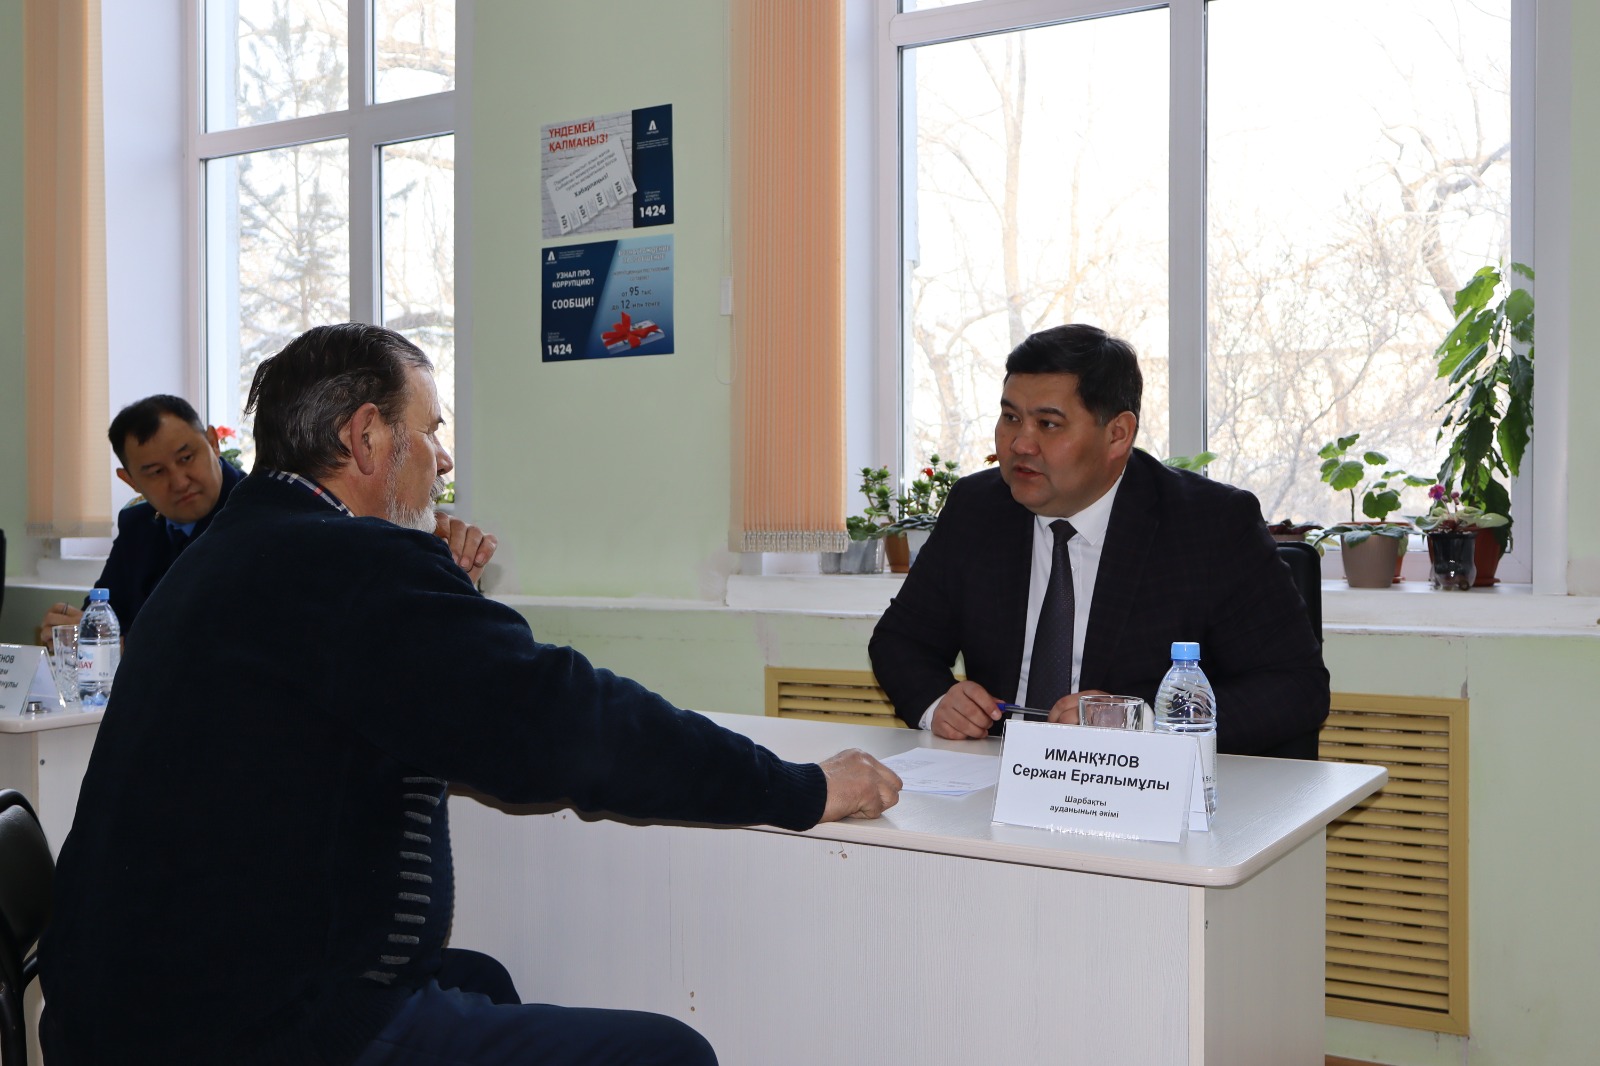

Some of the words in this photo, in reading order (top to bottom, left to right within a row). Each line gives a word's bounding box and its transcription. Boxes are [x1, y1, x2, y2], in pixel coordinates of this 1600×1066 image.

[549, 120, 595, 138] ҮНДЕМЕЙ
[549, 133, 609, 152] ҚАЛМАҢЫЗ!
[640, 204, 666, 218] 1424
[556, 270, 577, 279] УЗНАЛ
[577, 269, 591, 277] ПРО
[552, 278, 594, 288] КОРРУПЦИЮ?
[629, 286, 639, 296] 95
[552, 297, 594, 309] СООБЩИ!
[621, 299, 630, 309] 12
[548, 343, 572, 355] 1424
[1045, 748, 1139, 768] ИМАНҚҰЛОВ
[1012, 763, 1066, 780] Сержан
[1071, 769, 1169, 791] Ерғалымұлы
[1064, 795, 1106, 806] Шарбақты
[1049, 805, 1097, 816] ауданының
[1099, 810, 1119, 818] әкімі
